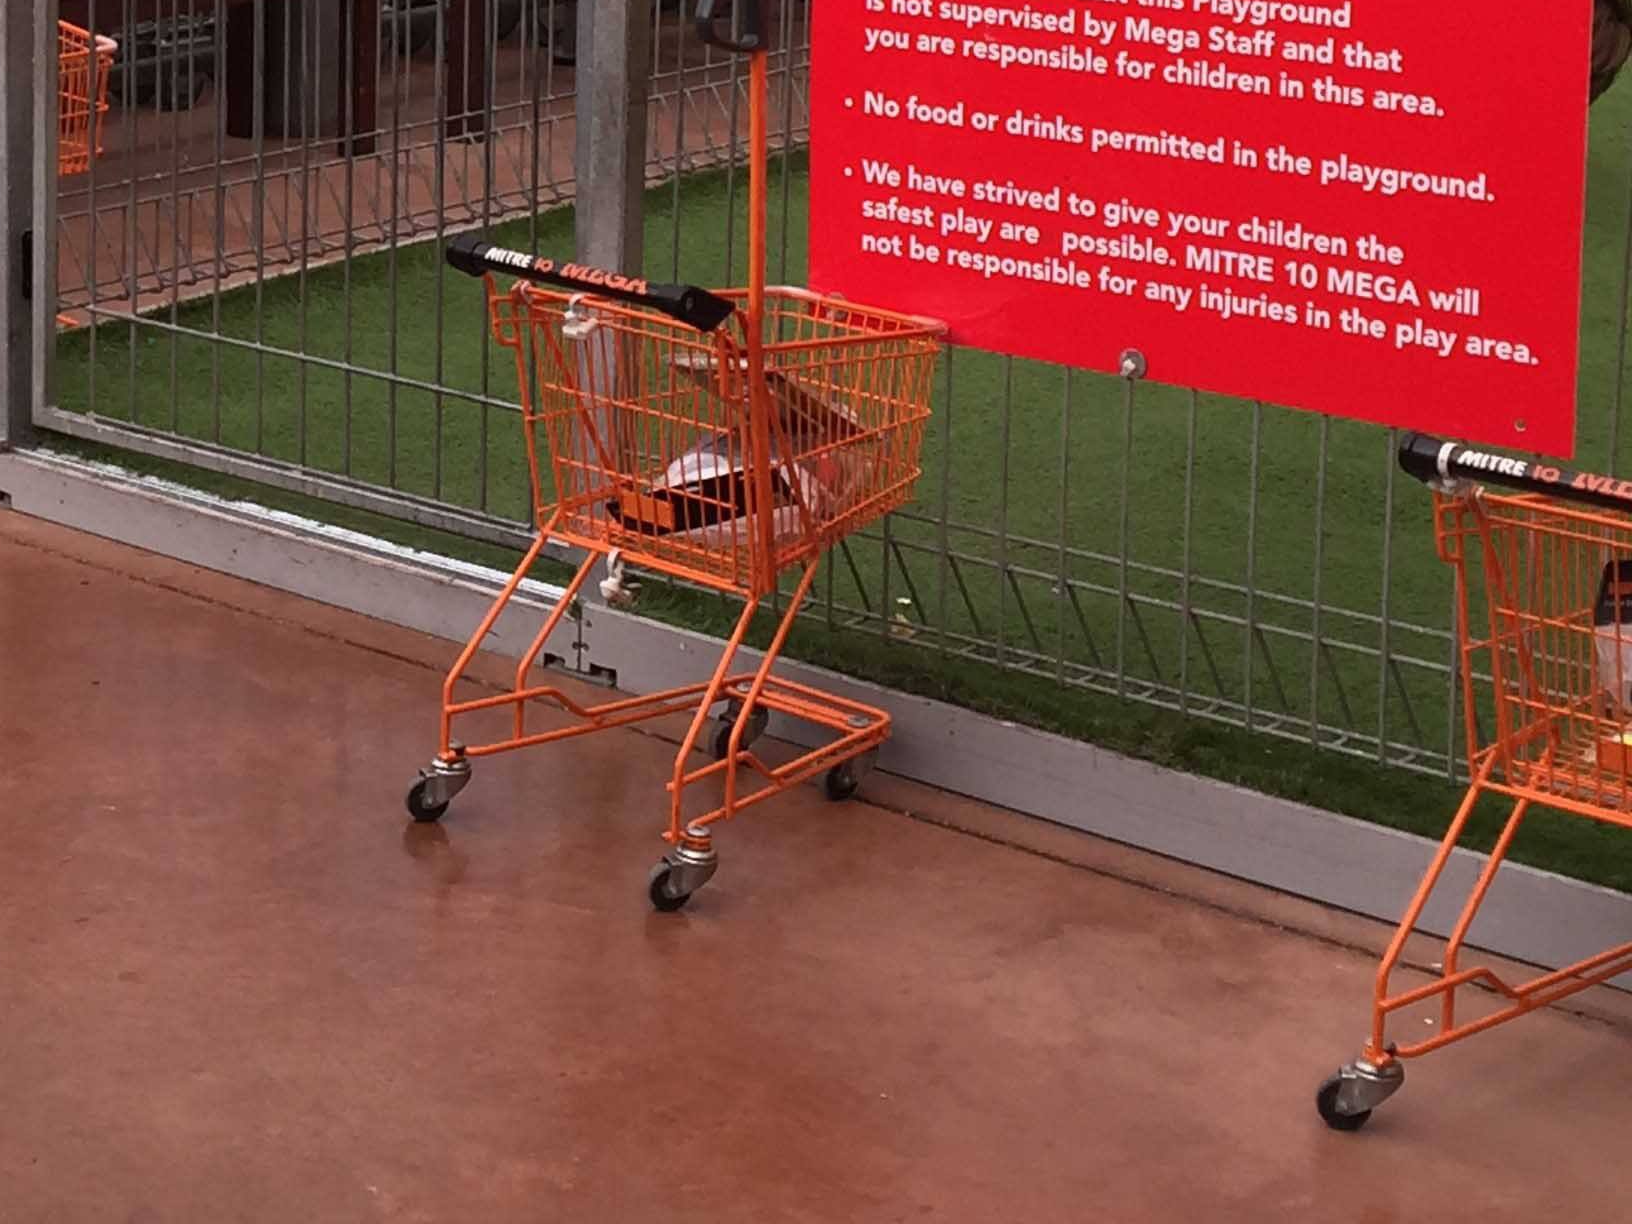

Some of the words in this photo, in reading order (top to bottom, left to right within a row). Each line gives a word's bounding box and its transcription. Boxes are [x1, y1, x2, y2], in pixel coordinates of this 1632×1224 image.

[865, 28, 910, 52] you
[917, 34, 956, 55] are
[963, 40, 1108, 75] responsible
[1115, 50, 1156, 80] for
[1164, 59, 1271, 96] children
[1279, 71, 1304, 99] in
[1312, 75, 1364, 106] this
[1373, 90, 1444, 117] area.
[939, 1, 1076, 35] supervised
[1084, 10, 1117, 45] by
[1125, 16, 1201, 54] Mega
[1209, 25, 1276, 57] Staff
[1283, 37, 1334, 64] and
[1342, 42, 1403, 73] that
[865, 91, 900, 118] No
[906, 96, 964, 127] food
[972, 112, 999, 131] or
[1006, 110, 1084, 144] drinks
[1092, 129, 1225, 165] permitted
[1234, 140, 1258, 168] in
[1266, 146, 1312, 176] the
[1321, 154, 1495, 203] playground.
[484, 247, 533, 268] MITRE
[534, 257, 554, 272] 10
[862, 197, 934, 228] safest
[942, 208, 993, 243] play
[1000, 222, 1040, 244] are
[1063, 233, 1177, 267] possible.
[1187, 245, 1274, 283] MITRE
[1284, 261, 1318, 289] 10
[1328, 268, 1420, 308] MEGA
[1429, 287, 1480, 316] will
[863, 160, 901, 187] We
[909, 166, 966, 197] have
[974, 180, 1060, 212] strived
[1068, 193, 1096, 217] to
[1104, 199, 1159, 228] give
[1167, 212, 1230, 238] your
[1238, 217, 1348, 258] children
[1356, 235, 1404, 265] the
[863, 235, 903, 257] not
[910, 235, 940, 263] be
[948, 250, 1091, 289] responsible
[1097, 265, 1138, 296] for
[1145, 281, 1193, 311] any
[1201, 284, 1298, 325] injuries
[1305, 301, 1331, 329] in
[1340, 307, 1387, 339] the
[1396, 319, 1457, 358] play
[1466, 336, 1539, 366] area.
[1457, 449, 1528, 478] MITRE
[1532, 464, 1561, 483] 10
